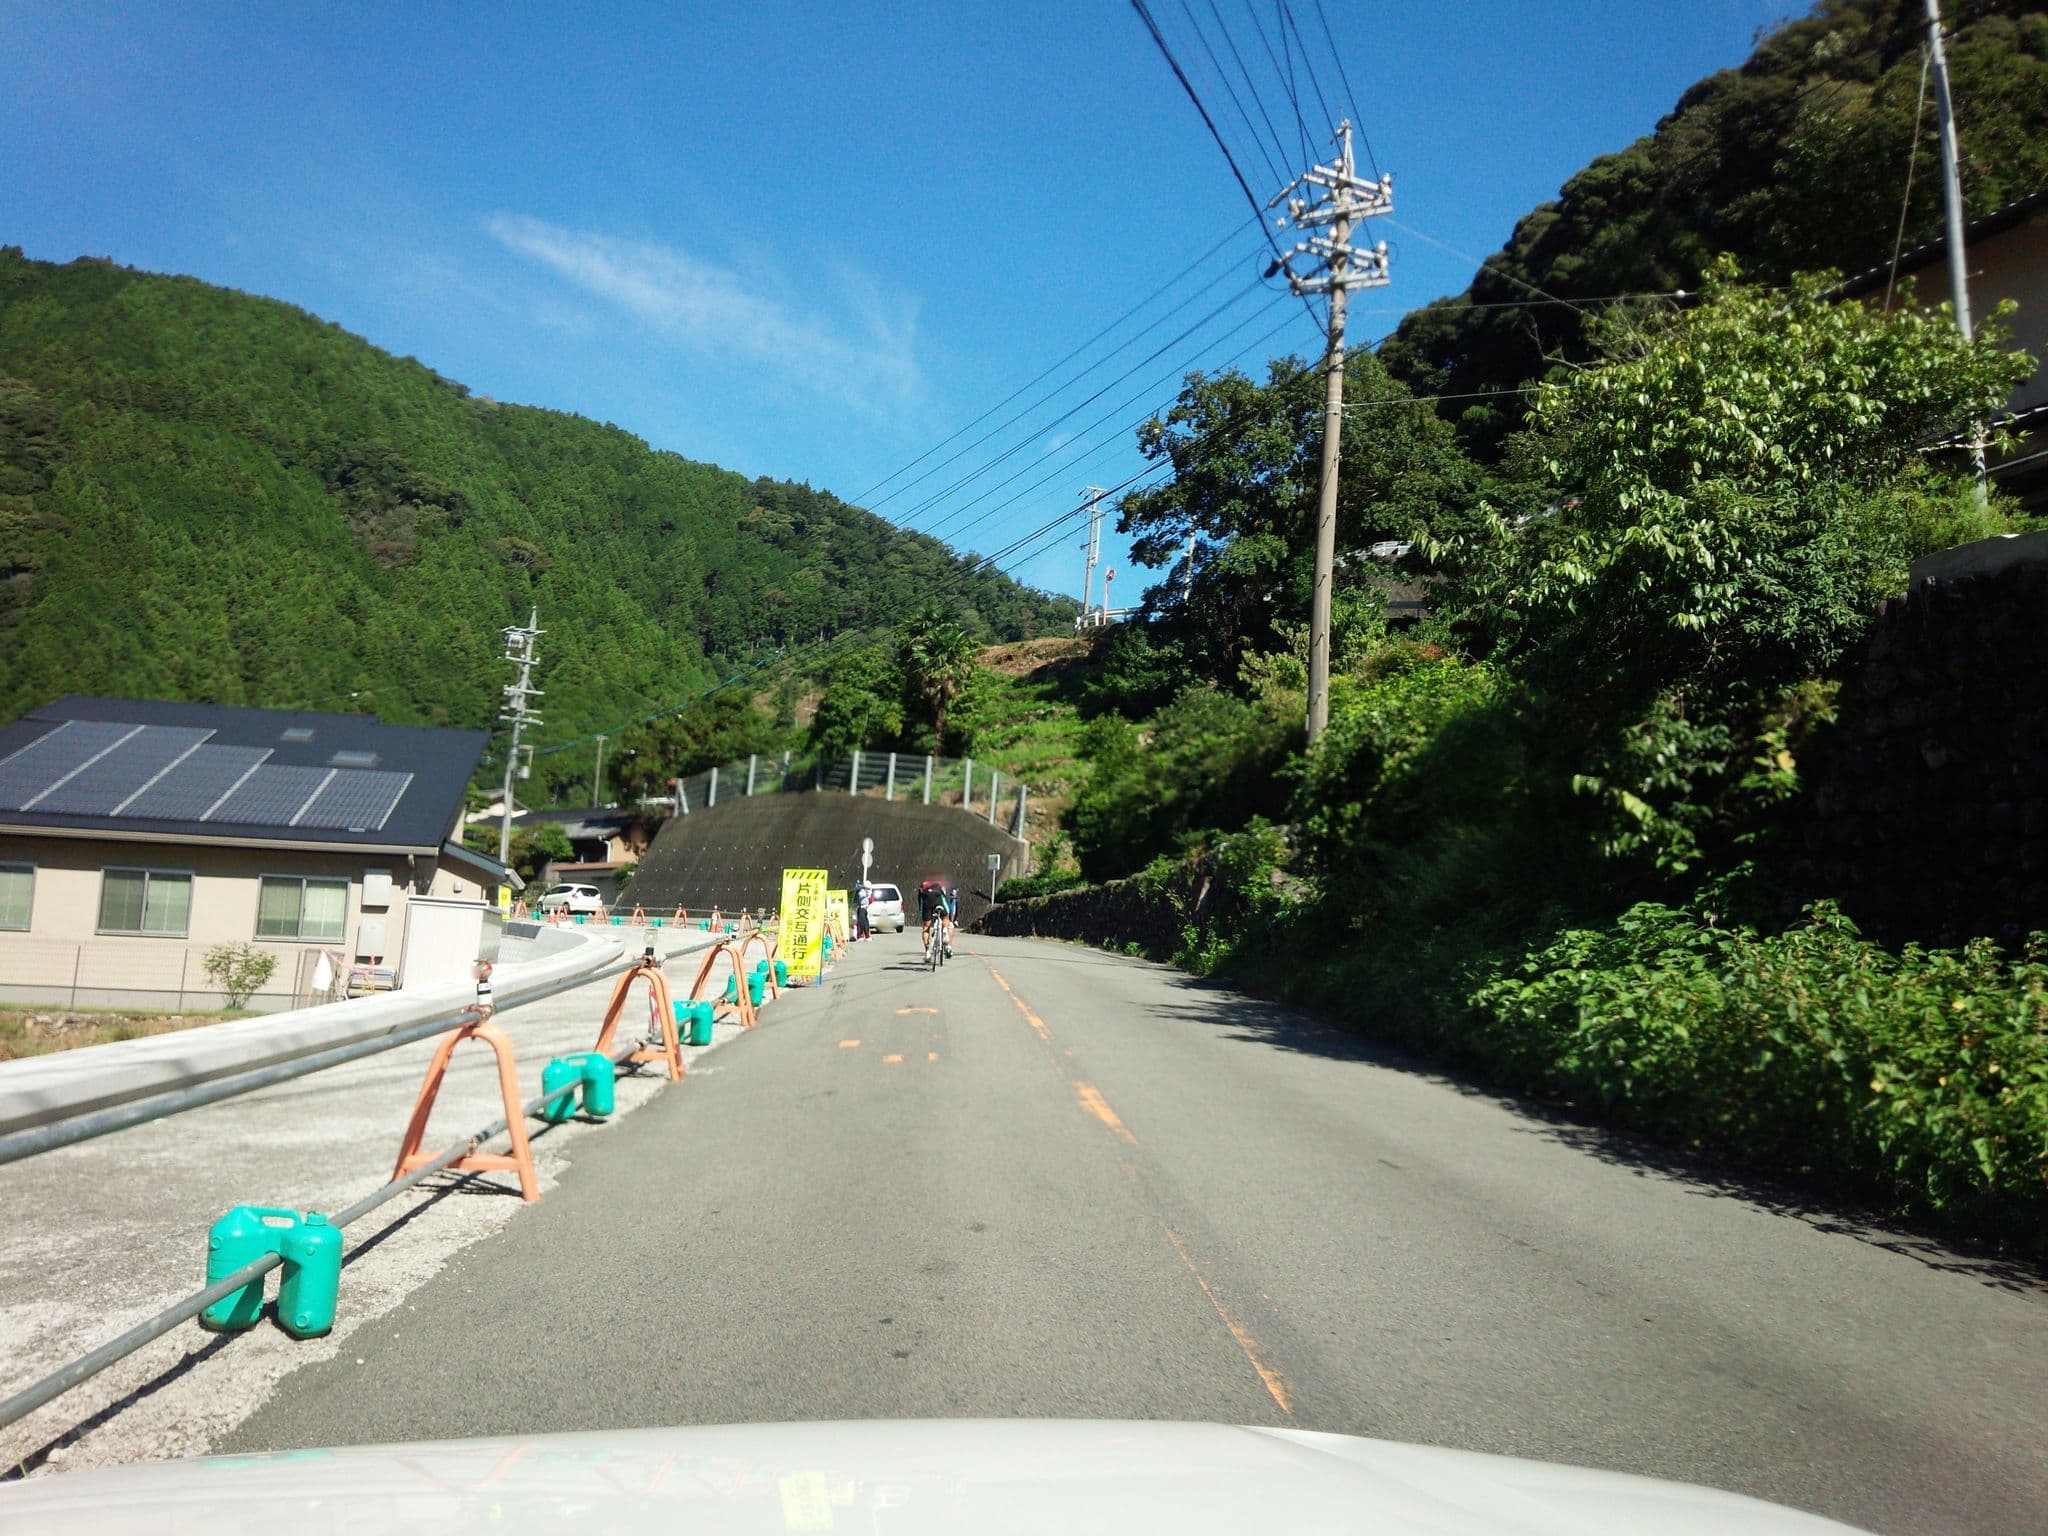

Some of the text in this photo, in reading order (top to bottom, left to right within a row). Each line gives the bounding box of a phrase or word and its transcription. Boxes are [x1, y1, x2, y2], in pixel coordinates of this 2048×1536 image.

[792, 882, 812, 960] 片側交互通行
